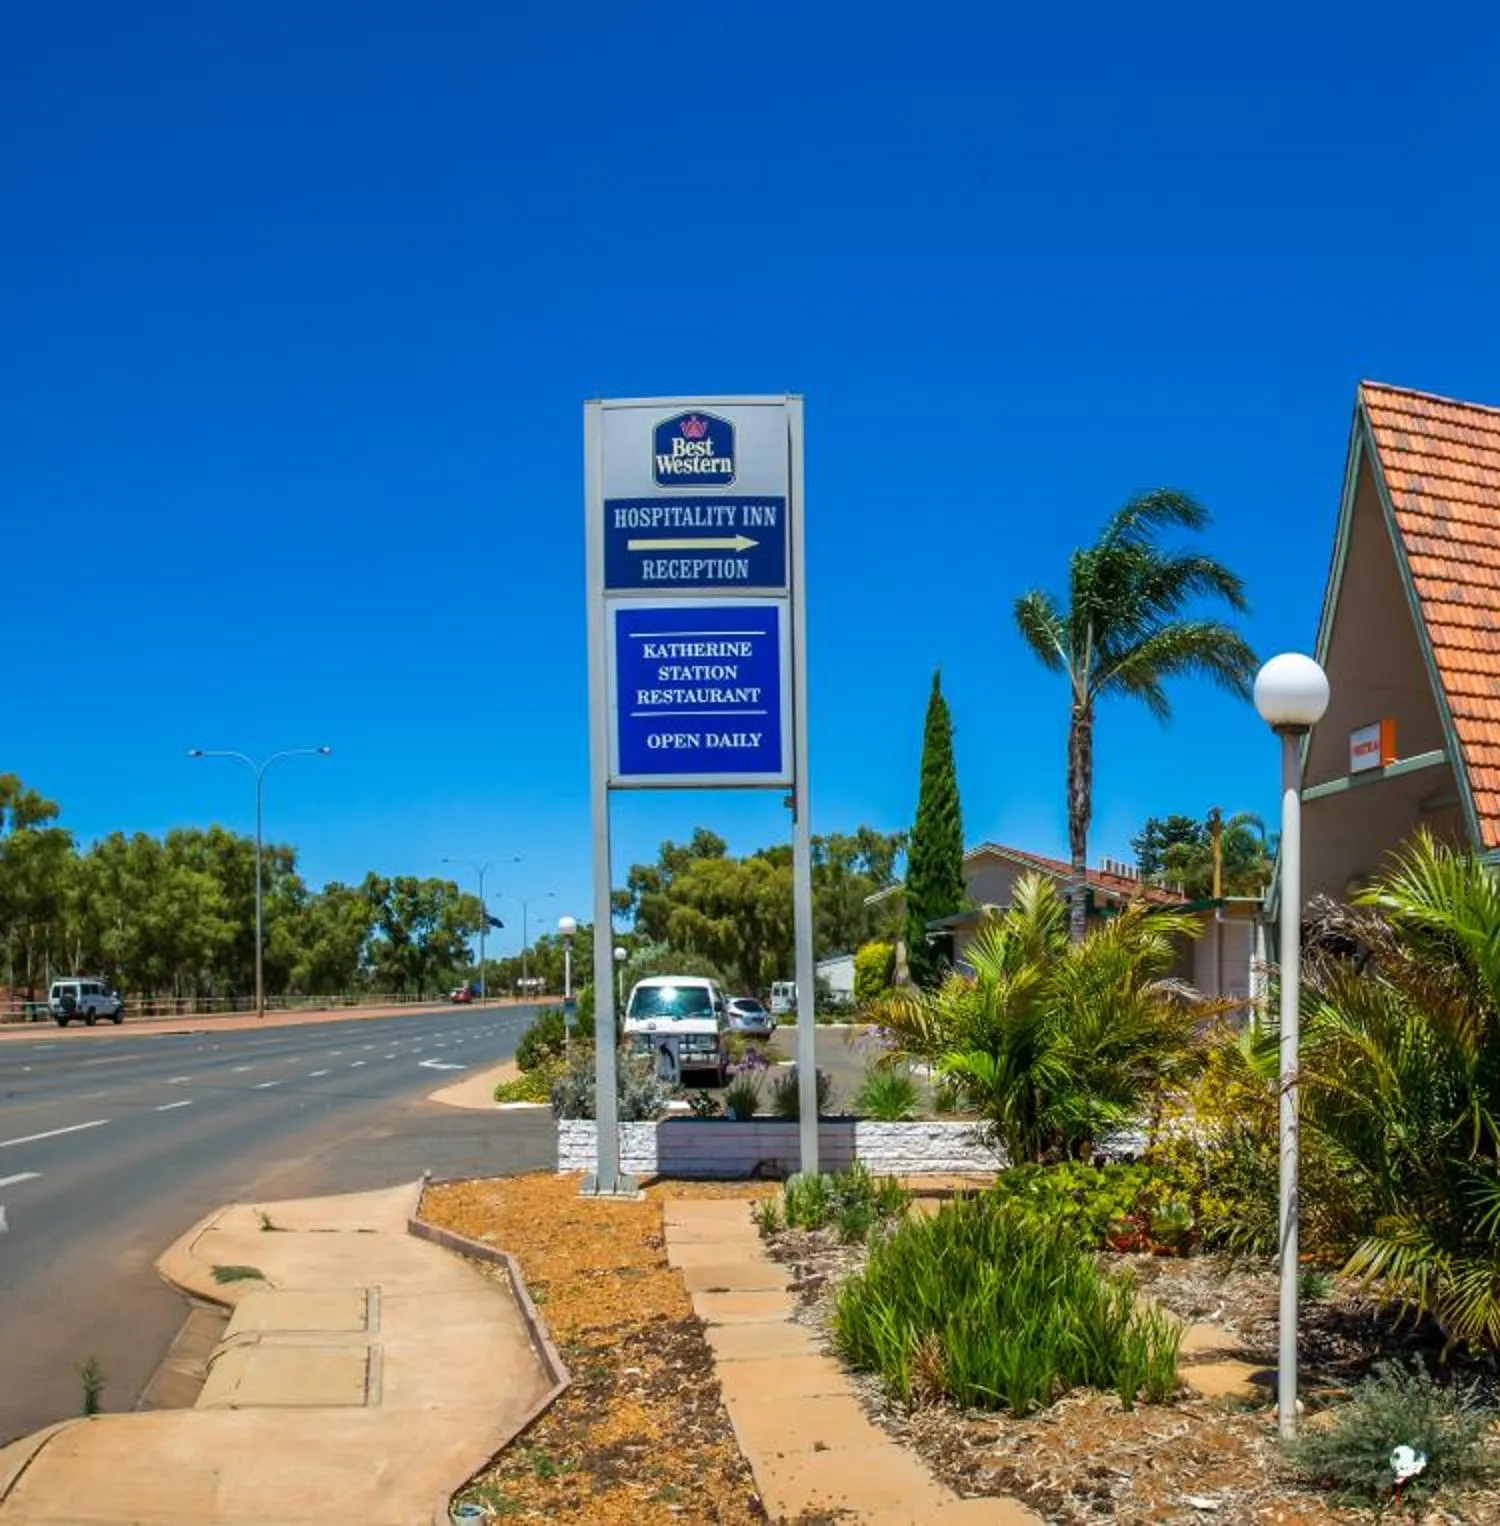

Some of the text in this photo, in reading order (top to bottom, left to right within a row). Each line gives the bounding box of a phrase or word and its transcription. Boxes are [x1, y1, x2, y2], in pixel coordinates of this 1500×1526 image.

[671, 437, 715, 457] Best
[656, 454, 733, 475] Western
[614, 506, 777, 528] HOSPITALITY INN
[642, 559, 749, 580] RECEPTION
[642, 641, 753, 659] KATHERINE
[658, 665, 738, 681] STATION
[637, 688, 761, 705] RESTAURANT
[647, 732, 763, 749] OPEN DAILY
